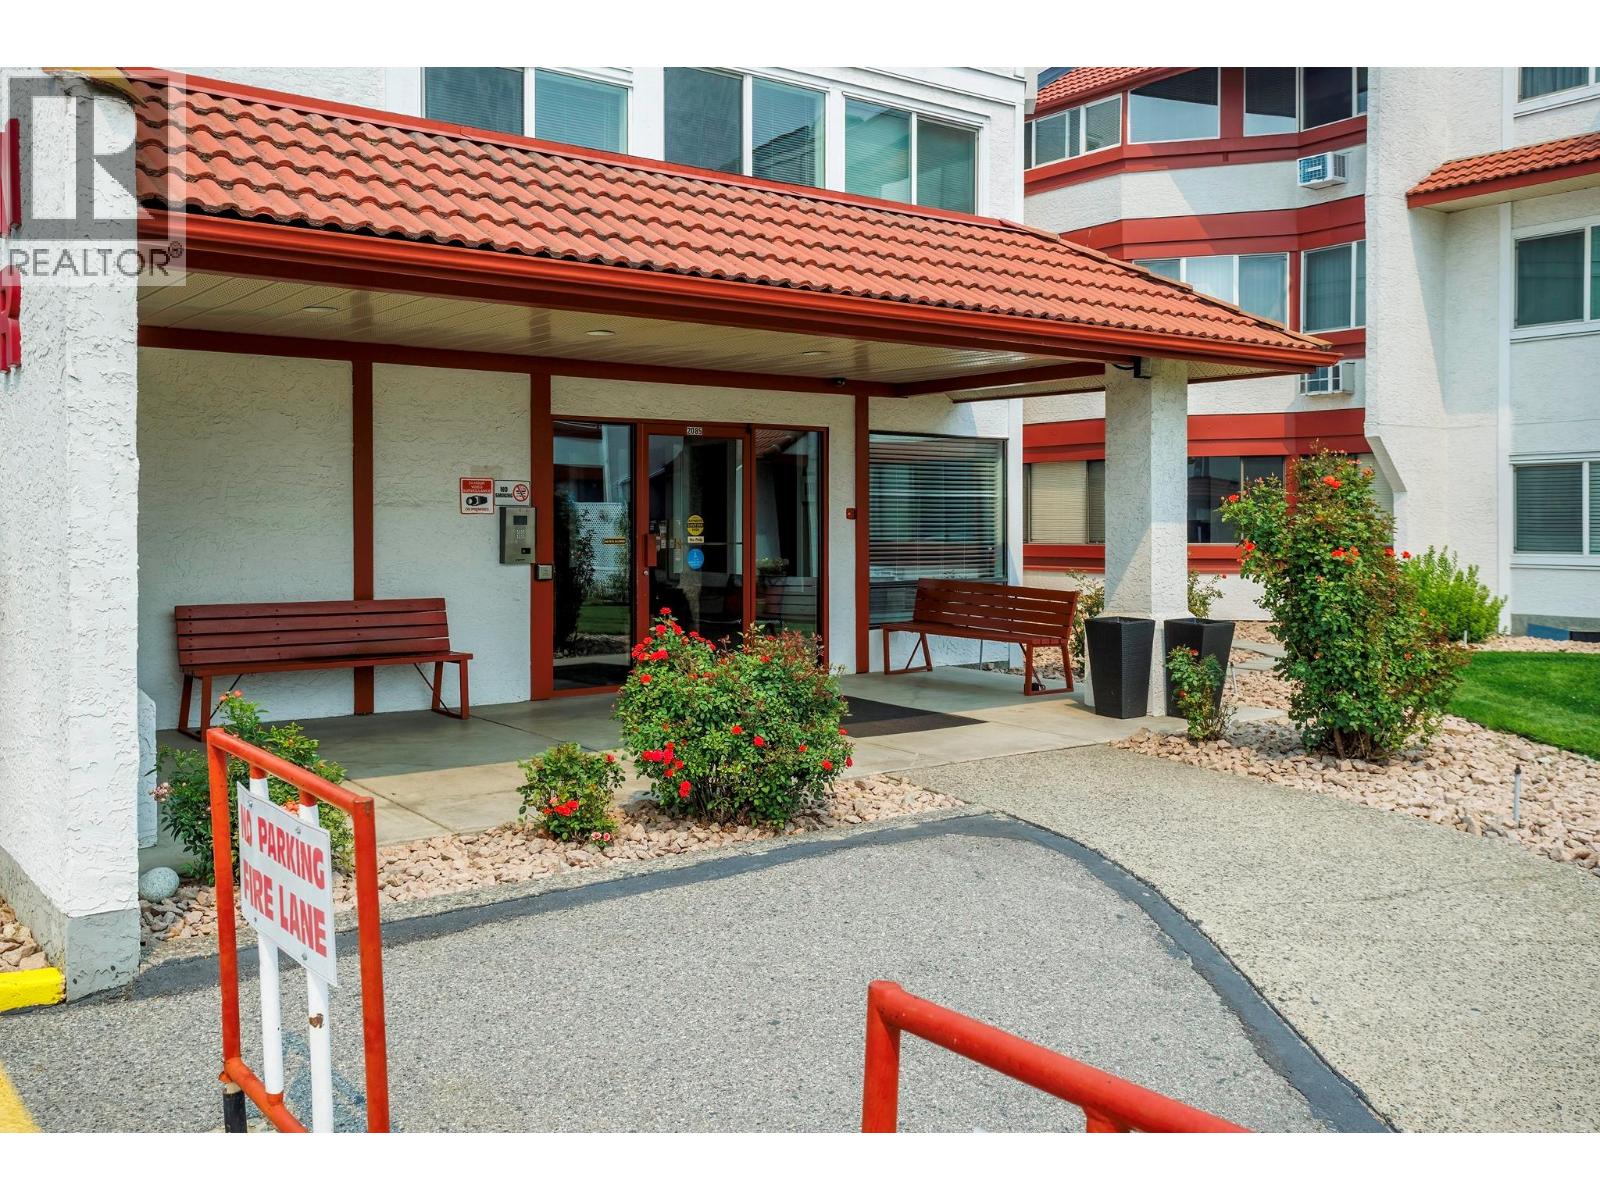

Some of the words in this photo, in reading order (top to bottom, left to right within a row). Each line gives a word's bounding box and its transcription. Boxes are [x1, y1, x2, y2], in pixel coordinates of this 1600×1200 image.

[687, 427, 702, 435] 2085
[240, 804, 252, 847] NO
[257, 816, 325, 890] PARKING
[243, 860, 274, 921] FIRE
[279, 885, 327, 957] LANE
